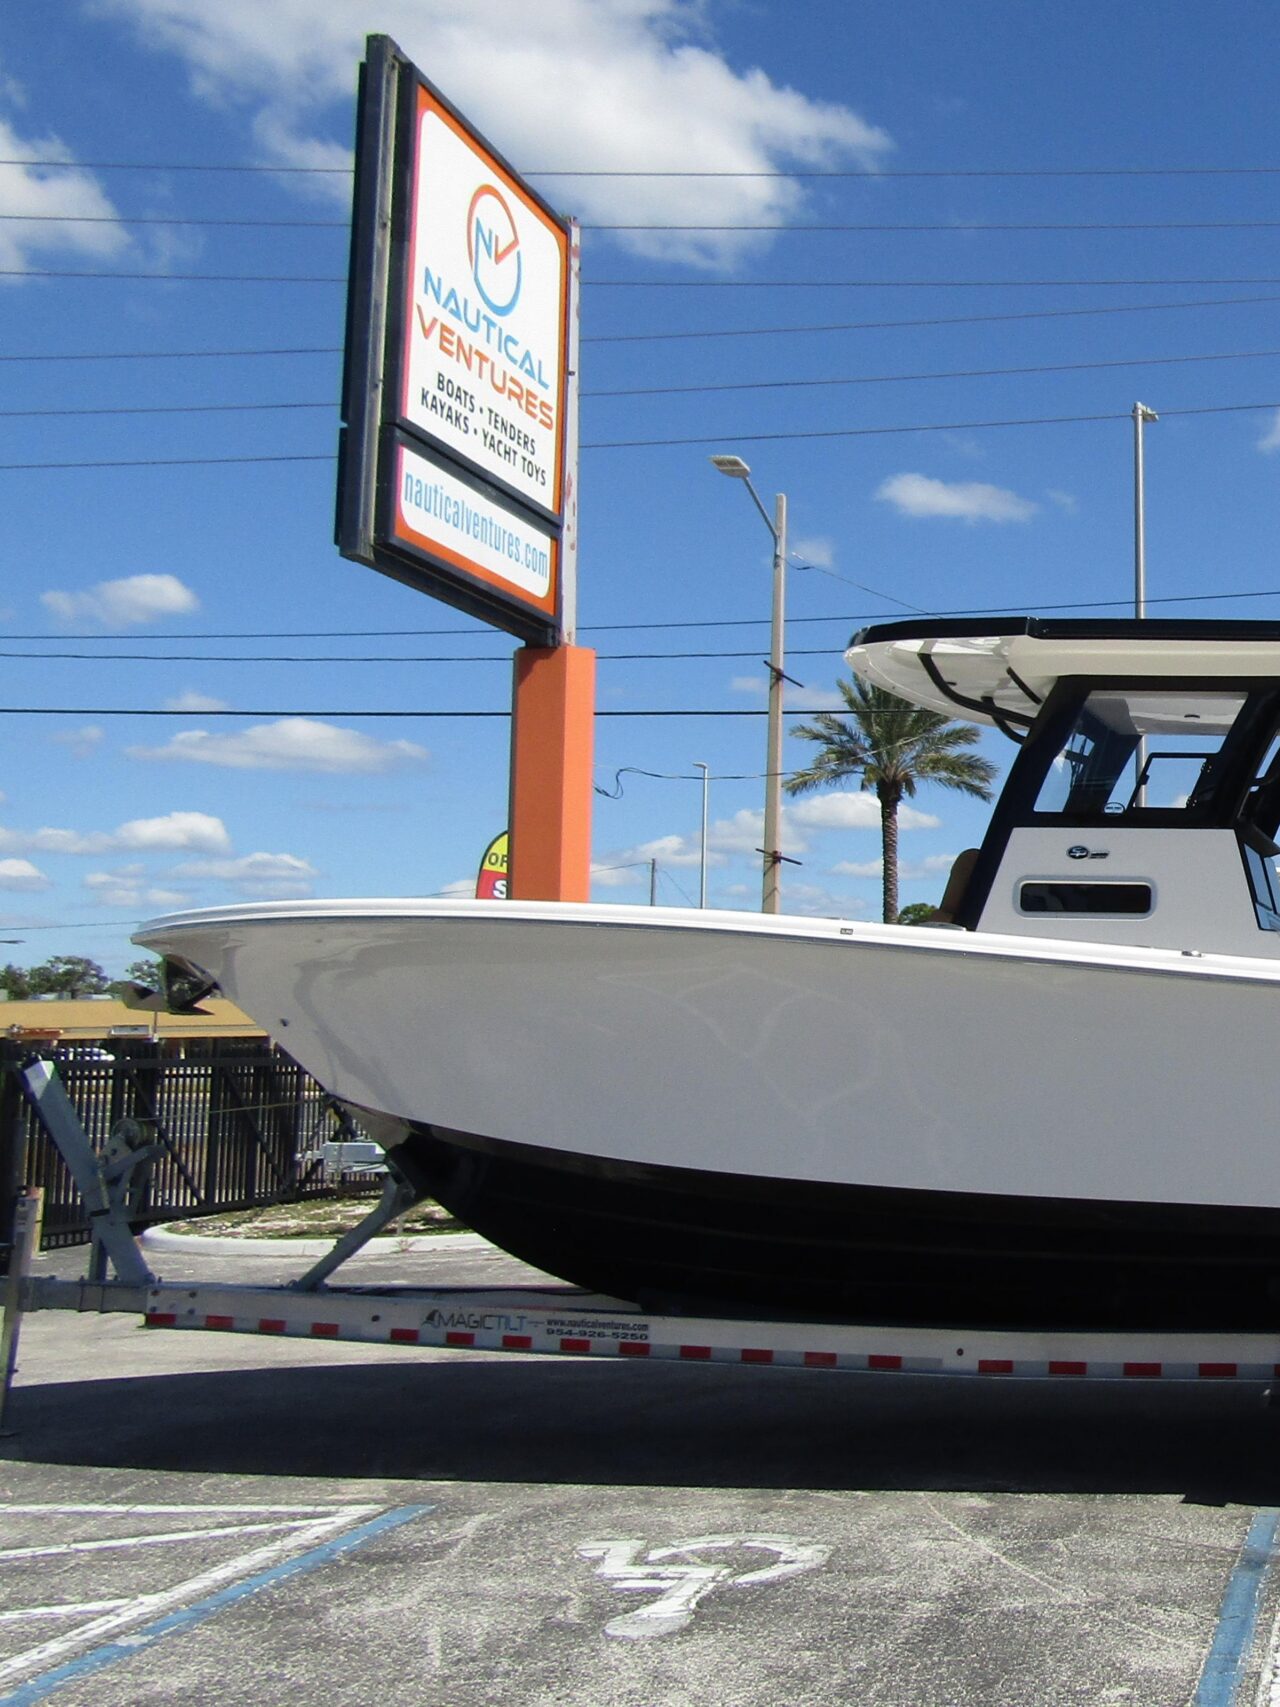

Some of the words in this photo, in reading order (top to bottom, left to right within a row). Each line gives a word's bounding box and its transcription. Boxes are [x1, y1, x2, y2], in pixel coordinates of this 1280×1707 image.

[416, 302, 554, 431] VENTURES
[423, 266, 550, 391] NAUTICAL
[420, 387, 470, 435] KAYAKS
[482, 428, 518, 467] YACHT
[521, 456, 547, 487] TOYS
[436, 371, 476, 414] BOATS
[487, 406, 536, 456] TENDERS
[404, 471, 548, 579] nauticalventures.com
[546, 1317, 649, 1331] www.nauticalventures.com
[546, 1328, 649, 1341] 954-926-5250
